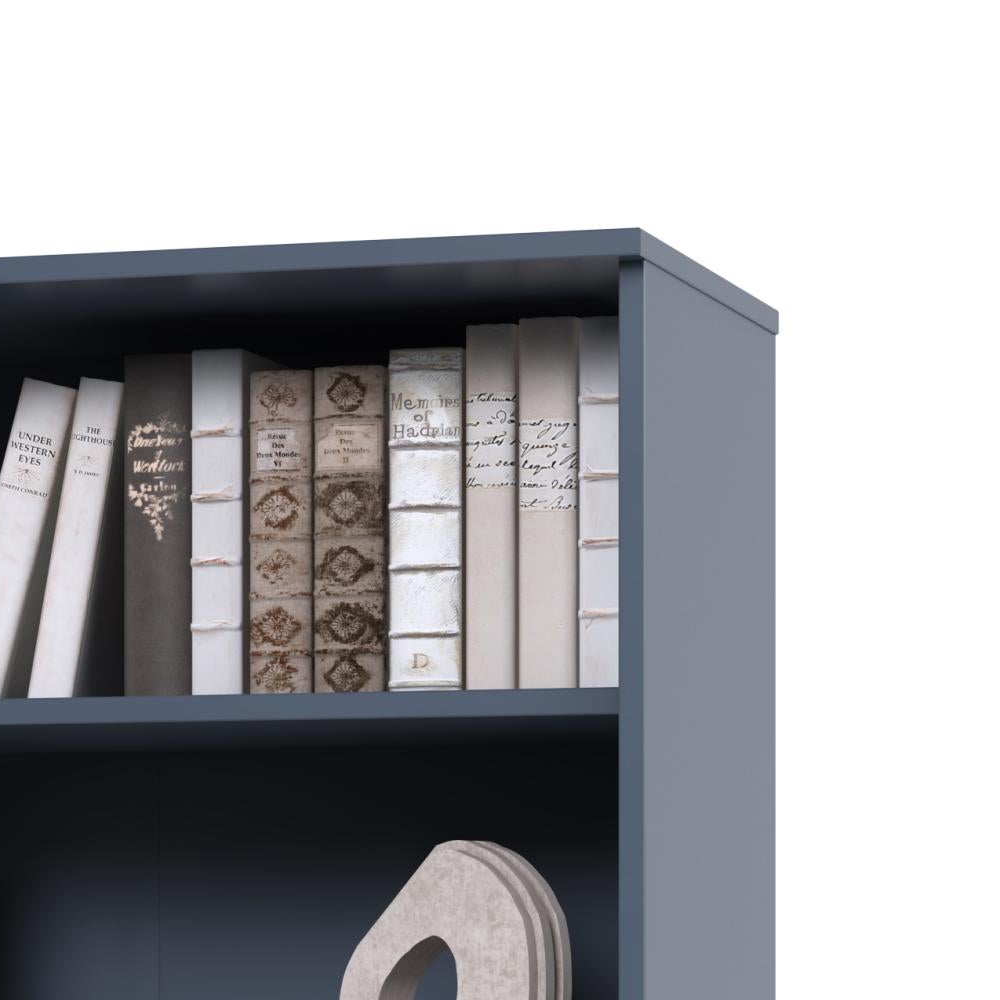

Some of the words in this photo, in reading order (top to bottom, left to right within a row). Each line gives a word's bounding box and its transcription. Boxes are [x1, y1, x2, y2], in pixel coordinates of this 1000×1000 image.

[391, 392, 461, 411] Memoirs
[413, 410, 434, 423] of
[87, 426, 102, 435] THE
[392, 423, 461, 440] Hadrian
[18, 431, 52, 447] UNDER
[71, 433, 116, 448] IGHTHOUS
[11, 441, 57, 458] WESTERN
[18, 454, 41, 466] EYES
[20, 487, 48, 498] CONRAD
[411, 653, 430, 669] D
